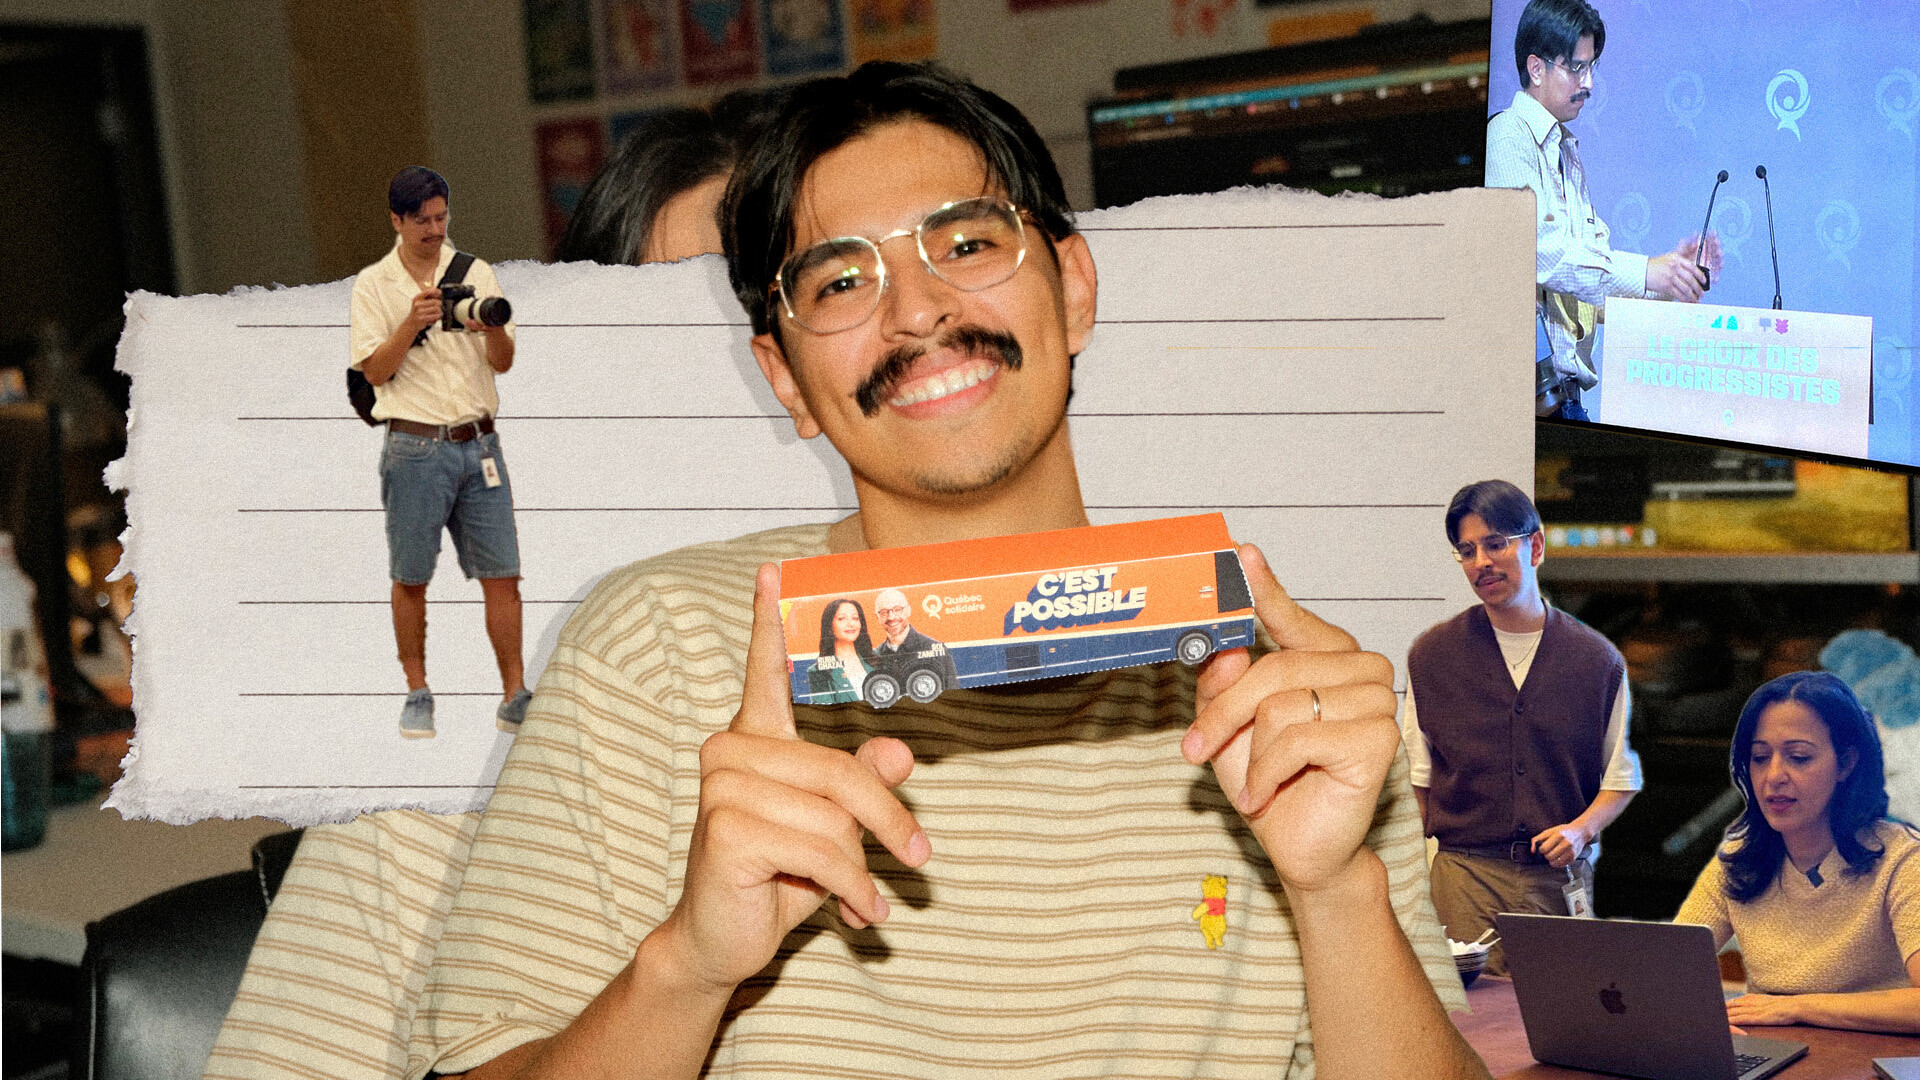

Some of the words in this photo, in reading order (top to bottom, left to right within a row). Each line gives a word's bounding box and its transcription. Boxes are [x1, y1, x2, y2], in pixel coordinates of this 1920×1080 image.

[1647, 333, 1674, 360] LE
[1679, 337, 1760, 368] CHOIX
[1766, 344, 1820, 374] DES
[1626, 358, 1841, 405] PROGRESSISTES
[1037, 566, 1118, 596] C'EST
[943, 594, 983, 605] Québec
[945, 603, 986, 615] solidaire
[1013, 586, 1147, 623] POSSIBLE
[917, 649, 946, 659] ZANETTI
